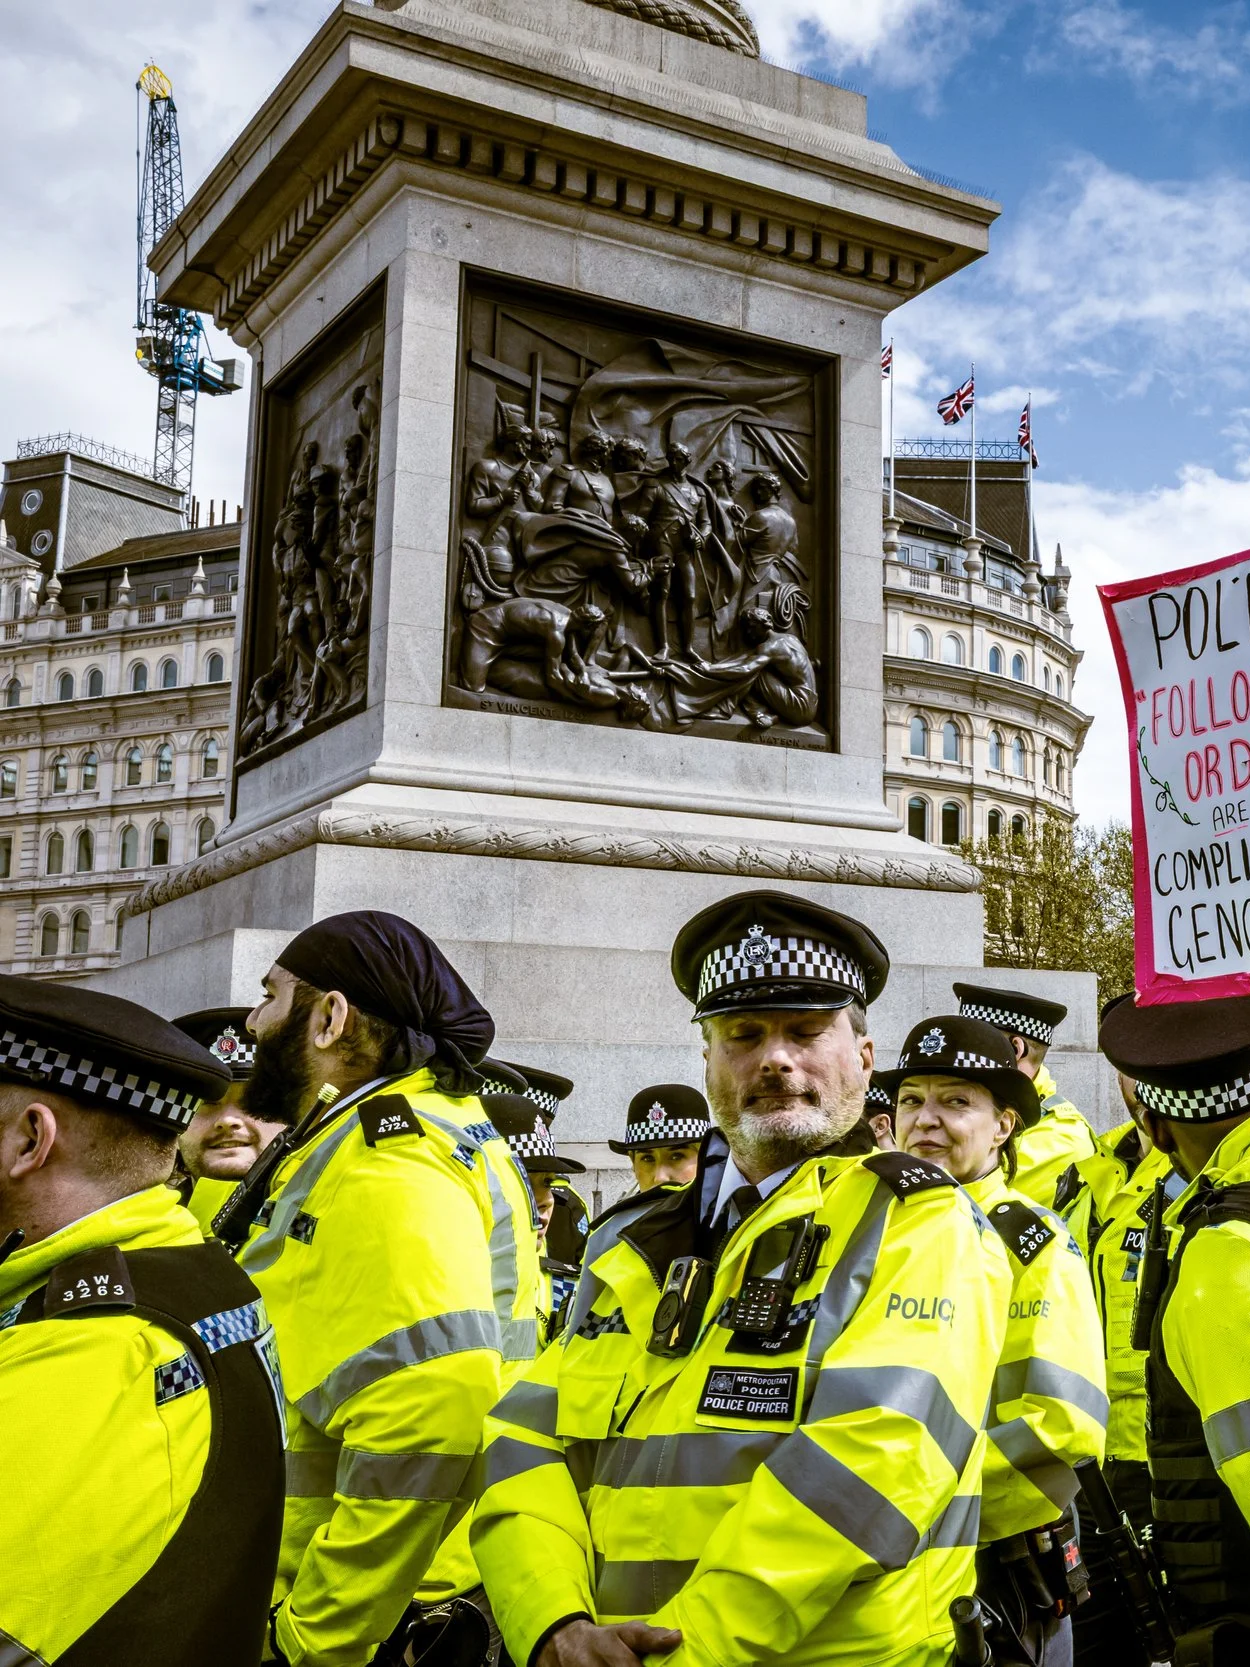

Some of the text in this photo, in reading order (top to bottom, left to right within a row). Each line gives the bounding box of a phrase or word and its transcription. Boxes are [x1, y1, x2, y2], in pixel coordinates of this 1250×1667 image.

[497, 702, 554, 718] VINCENT
[1212, 800, 1250, 833] ARE
[377, 1121, 409, 1133] 4724
[1020, 1228, 1051, 1258] 3801
[63, 1284, 124, 1301] 3263
[885, 1293, 955, 1324] POLIC
[1008, 1299, 1050, 1319] OLICE
[736, 1376, 788, 1386] METROPOLITAN
[741, 1386, 780, 1396] POLICE
[703, 1397, 789, 1414] POLICE OFFICER
